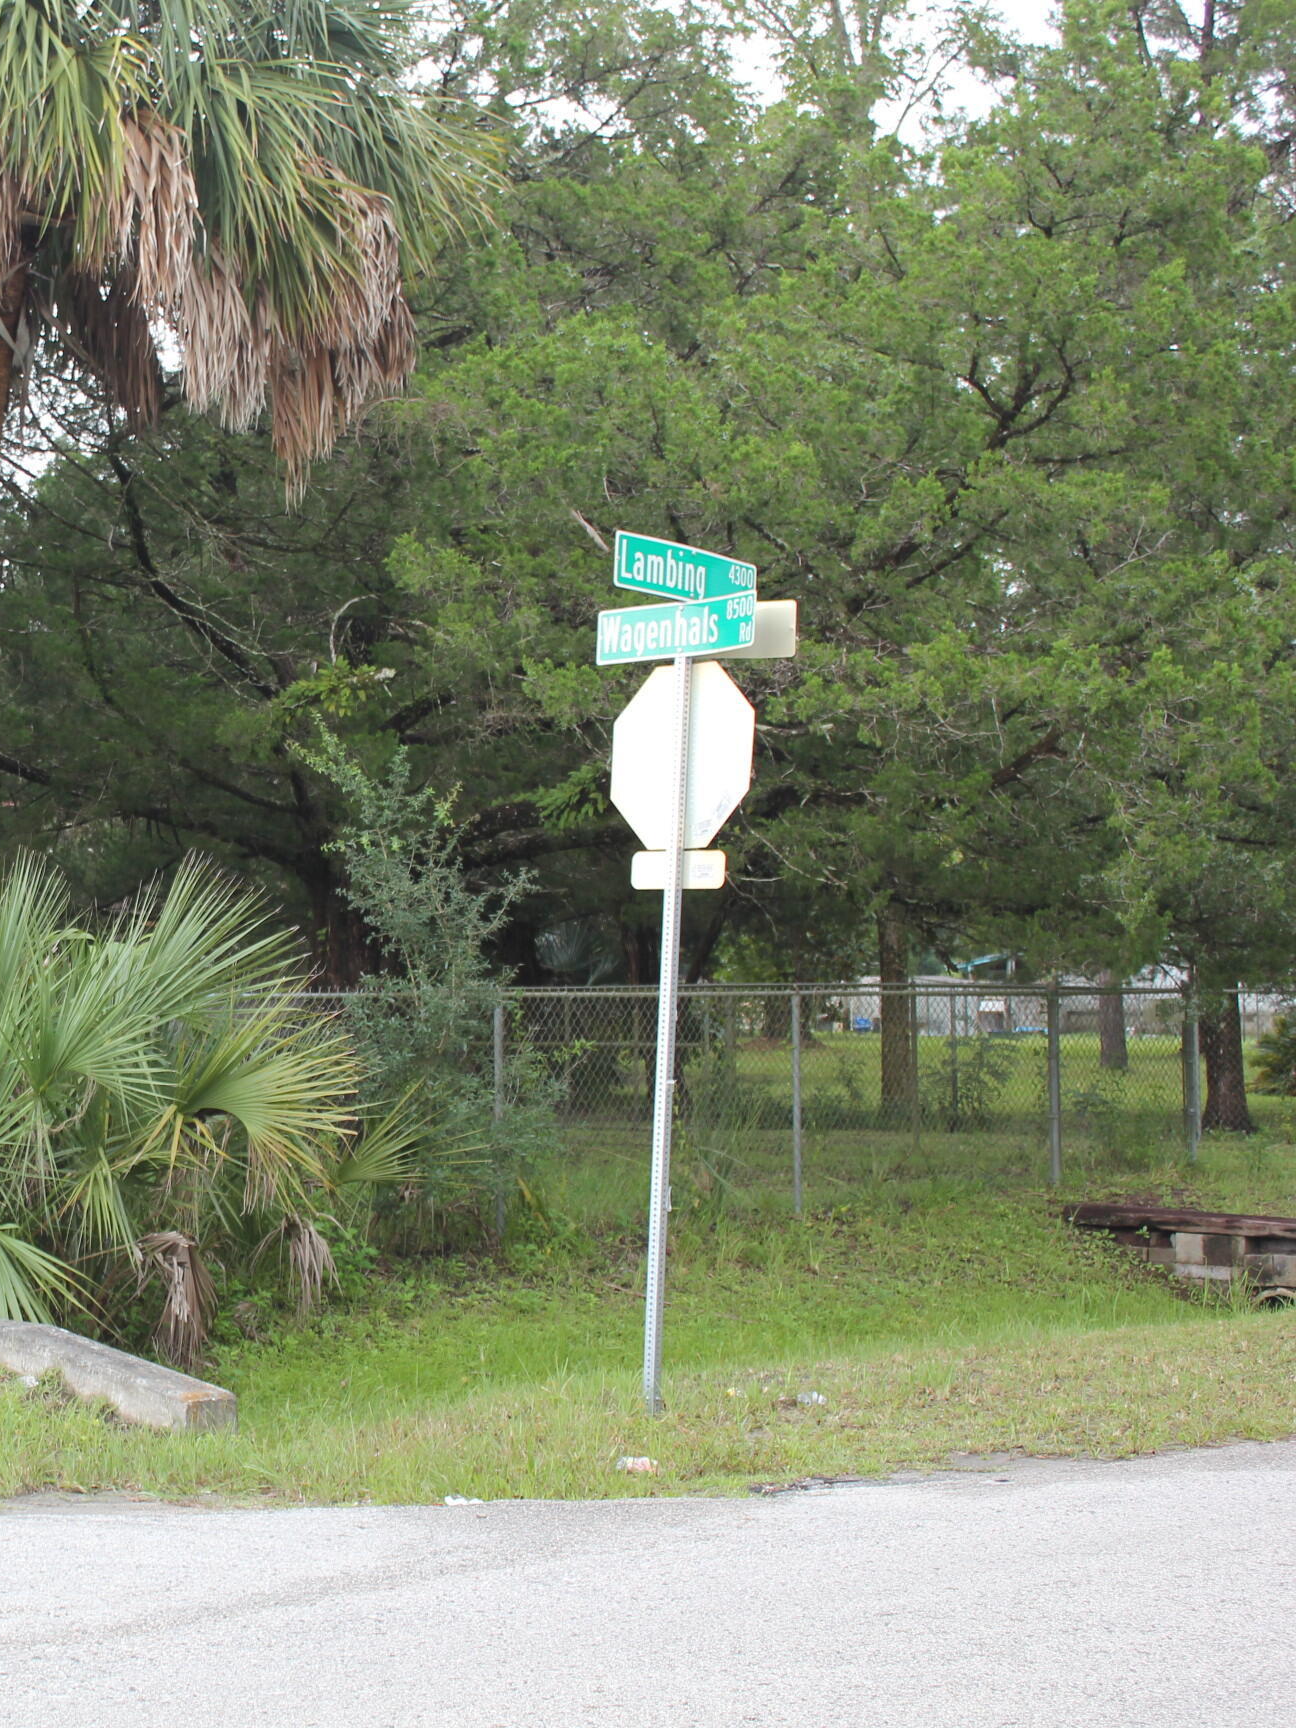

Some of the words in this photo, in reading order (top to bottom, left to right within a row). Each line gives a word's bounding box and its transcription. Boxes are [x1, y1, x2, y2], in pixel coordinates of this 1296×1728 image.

[620, 538, 707, 600] Lambing
[728, 564, 754, 589] 4300
[726, 595, 754, 620] 8500
[602, 604, 719, 656] Wagenhals
[738, 621, 752, 642] Rd
